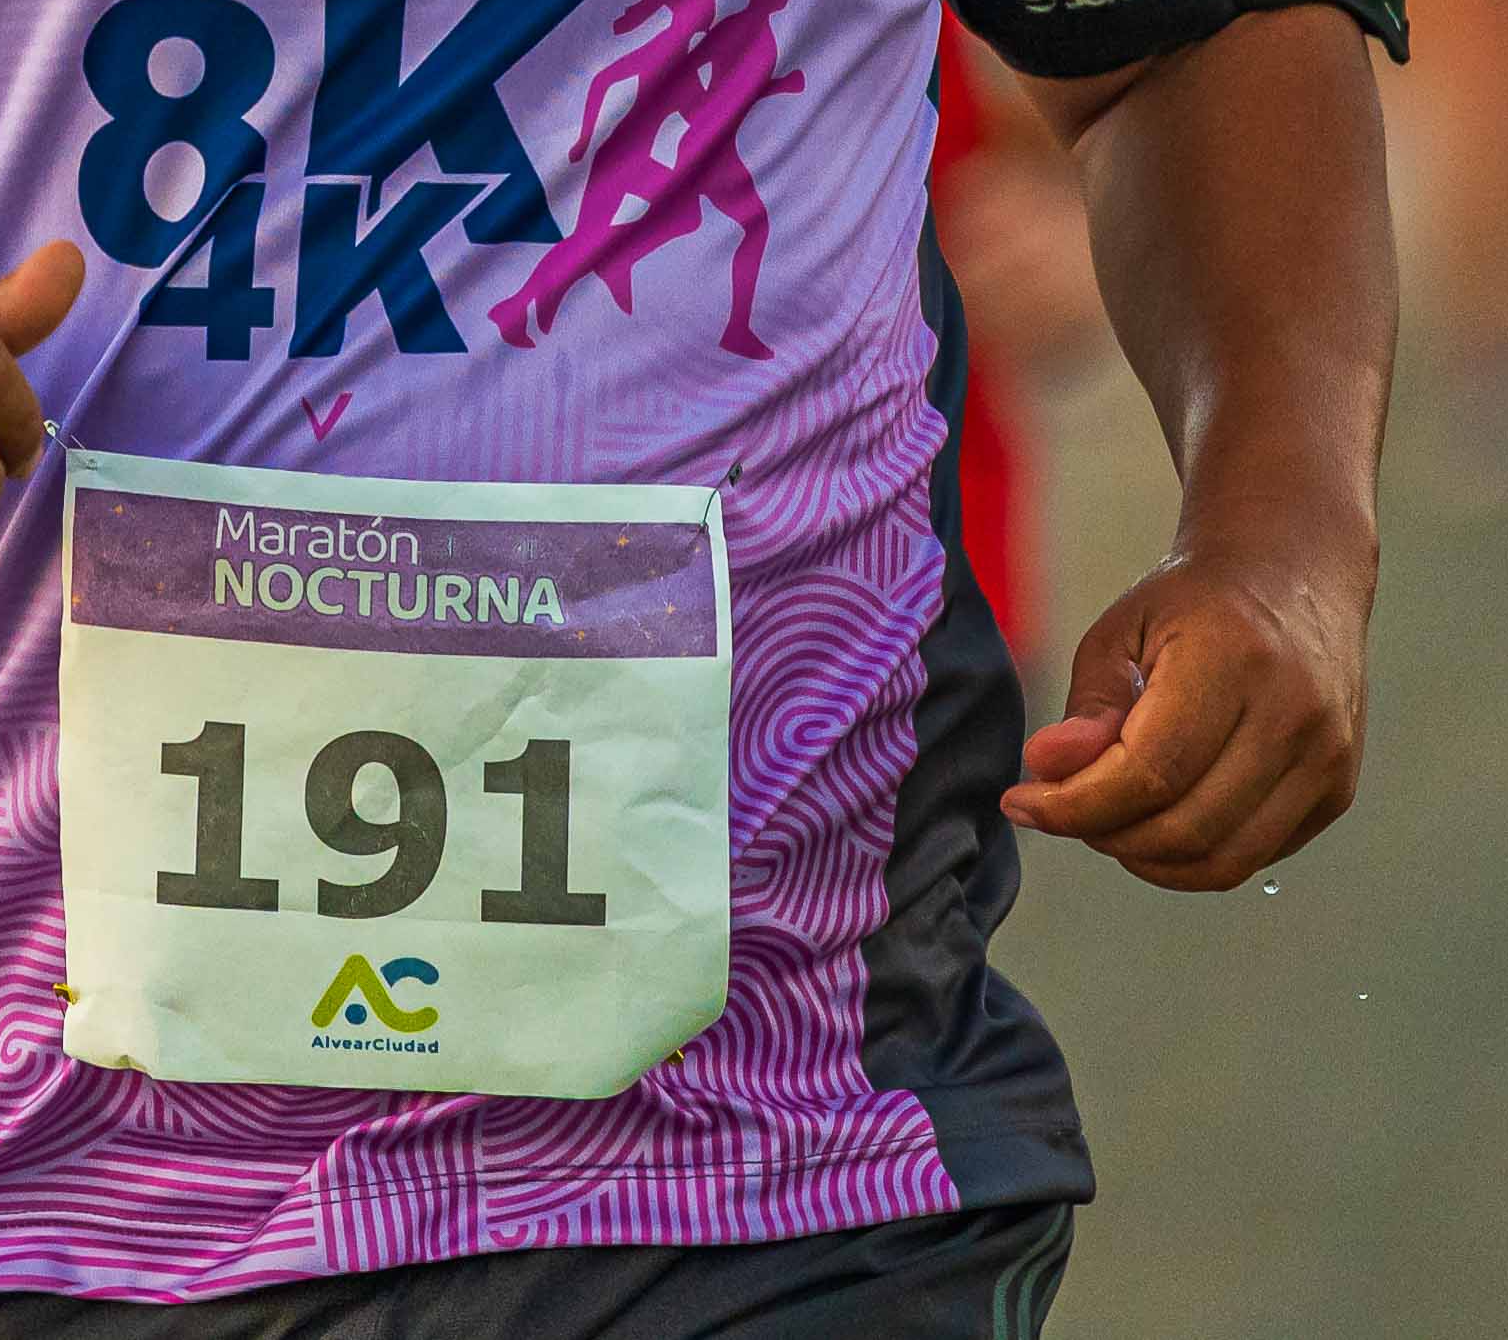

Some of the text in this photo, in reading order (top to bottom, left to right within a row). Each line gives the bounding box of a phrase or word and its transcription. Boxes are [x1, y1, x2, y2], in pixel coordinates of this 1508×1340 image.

[137, 178, 470, 363] 4K
[213, 558, 566, 626] NOCTURNA
[214, 507, 419, 566] Maratón
[155, 719, 608, 928] 191
